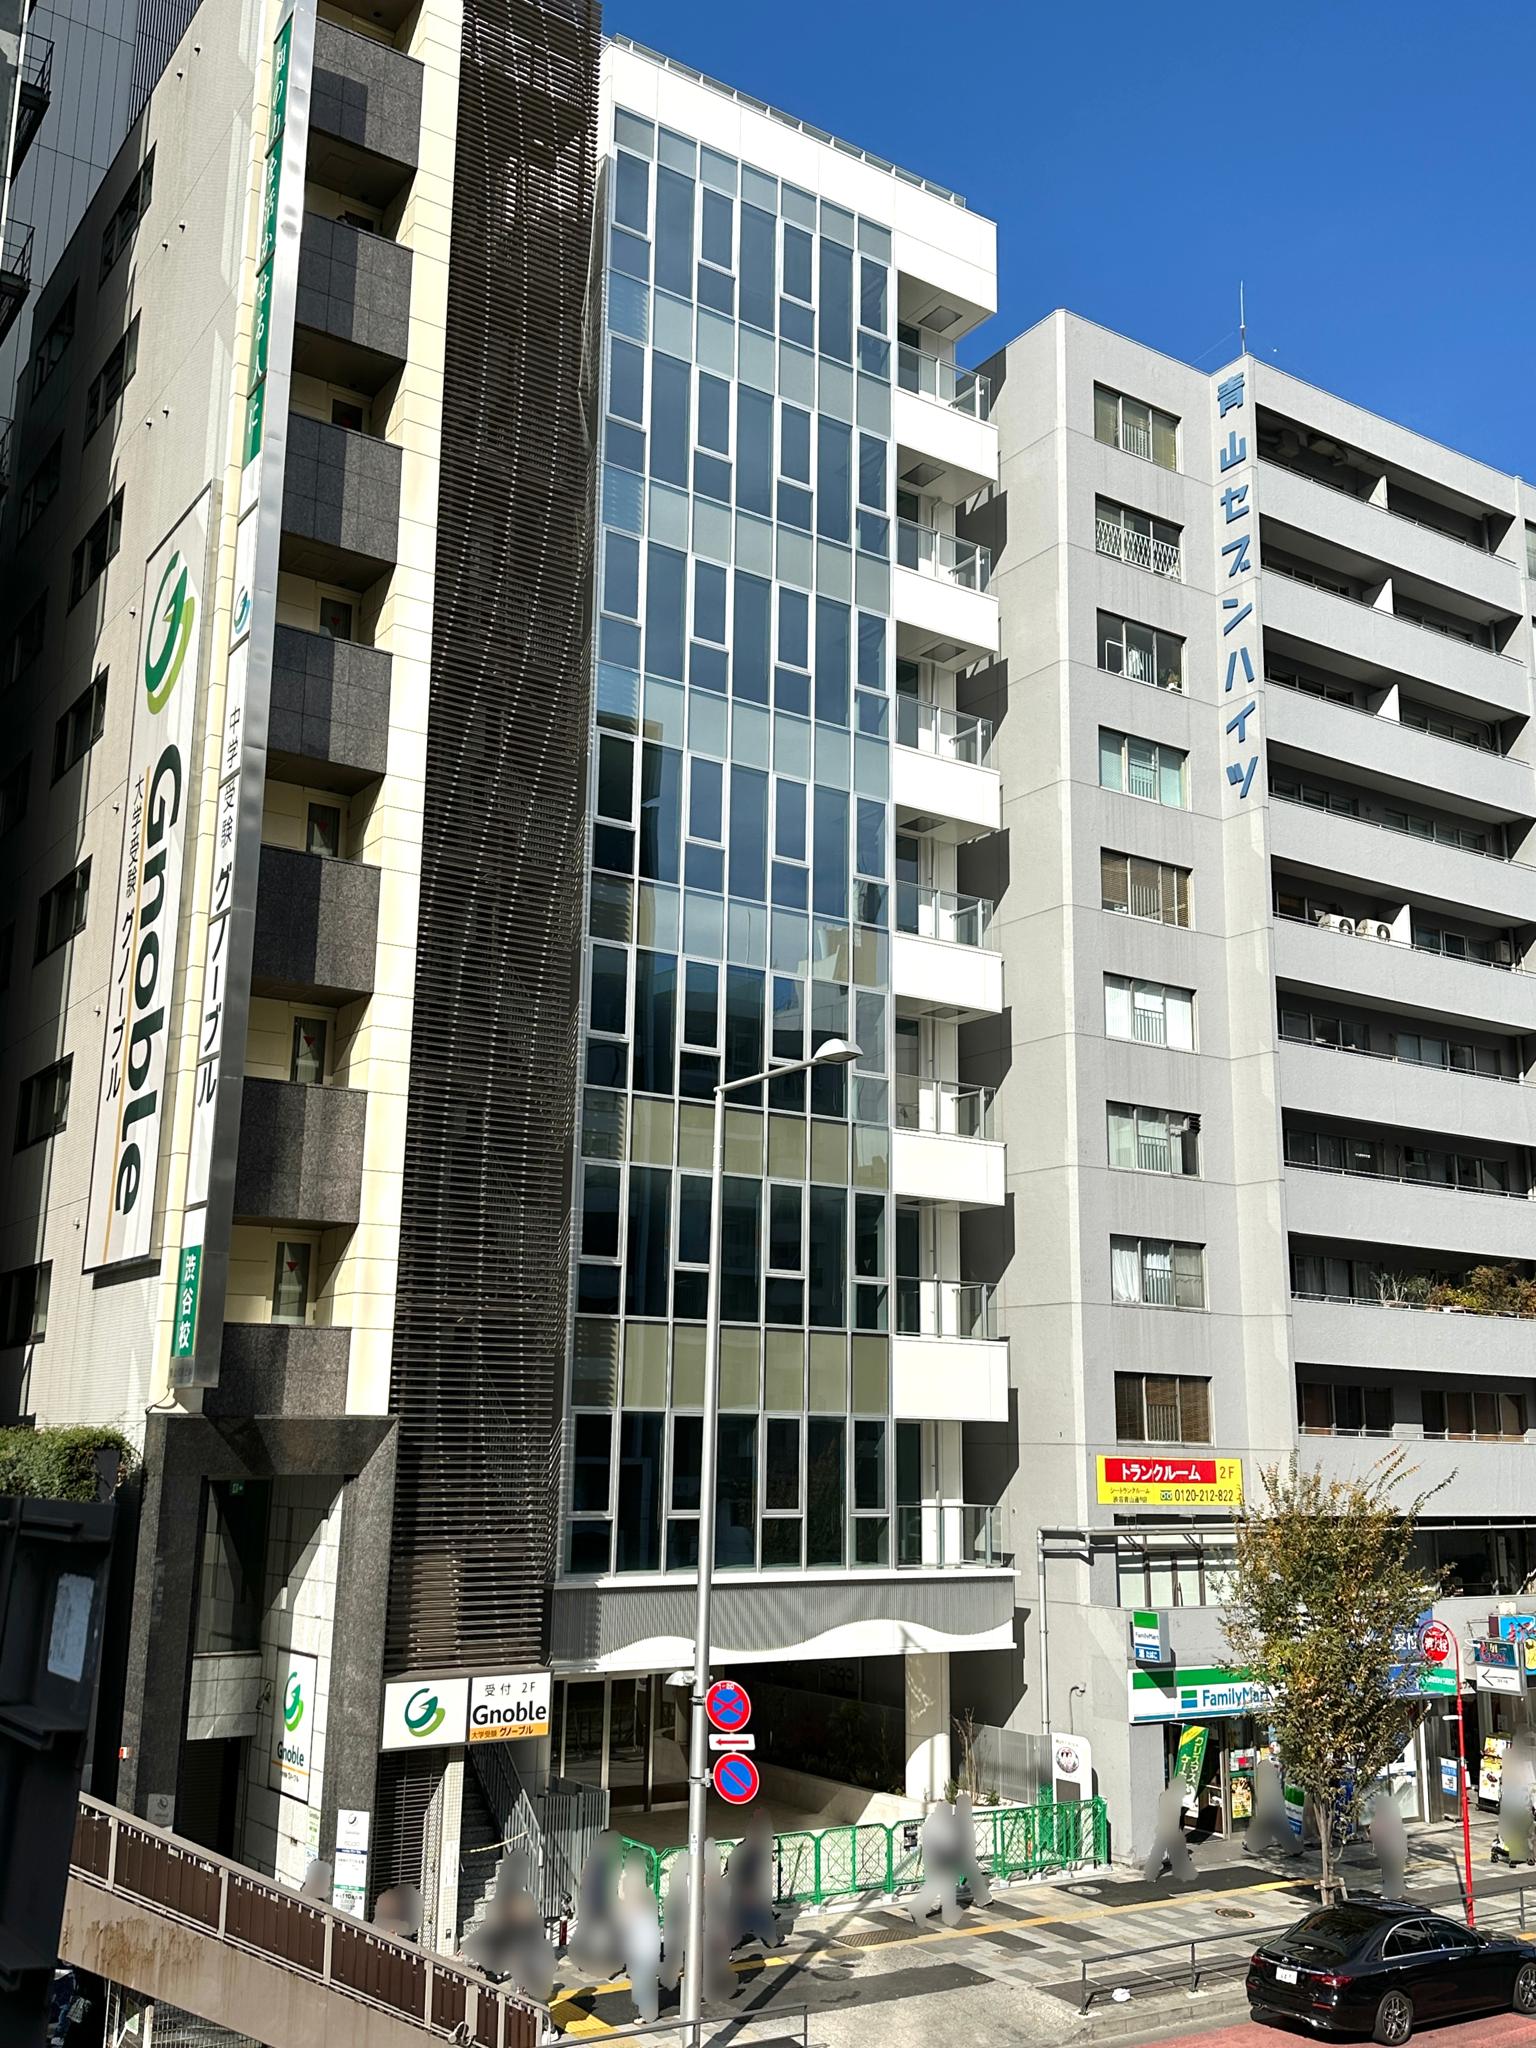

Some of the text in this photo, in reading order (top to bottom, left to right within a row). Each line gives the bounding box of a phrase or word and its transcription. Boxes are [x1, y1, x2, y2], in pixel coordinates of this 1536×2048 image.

[1217, 371, 1258, 799] 青山セブンハイツ
[197, 706, 241, 1108] 中学受験 グノーブル
[106, 775, 145, 1102] 大学受験 グノーブル
[115, 744, 182, 1215] Gnoble
[178, 1254, 197, 1349] 渋谷校
[1121, 1463, 1235, 1481] トランクルーム 2F
[1174, 1489, 1234, 1502] 0120-212-822
[484, 1681, 536, 1697] 受付 2F
[472, 1700, 547, 1726] Gnoble
[471, 1724, 534, 1740] 大学受験 グノーブル
[277, 1741, 305, 1767] Gnoble
[1190, 1737, 1204, 1783] クリスマス
